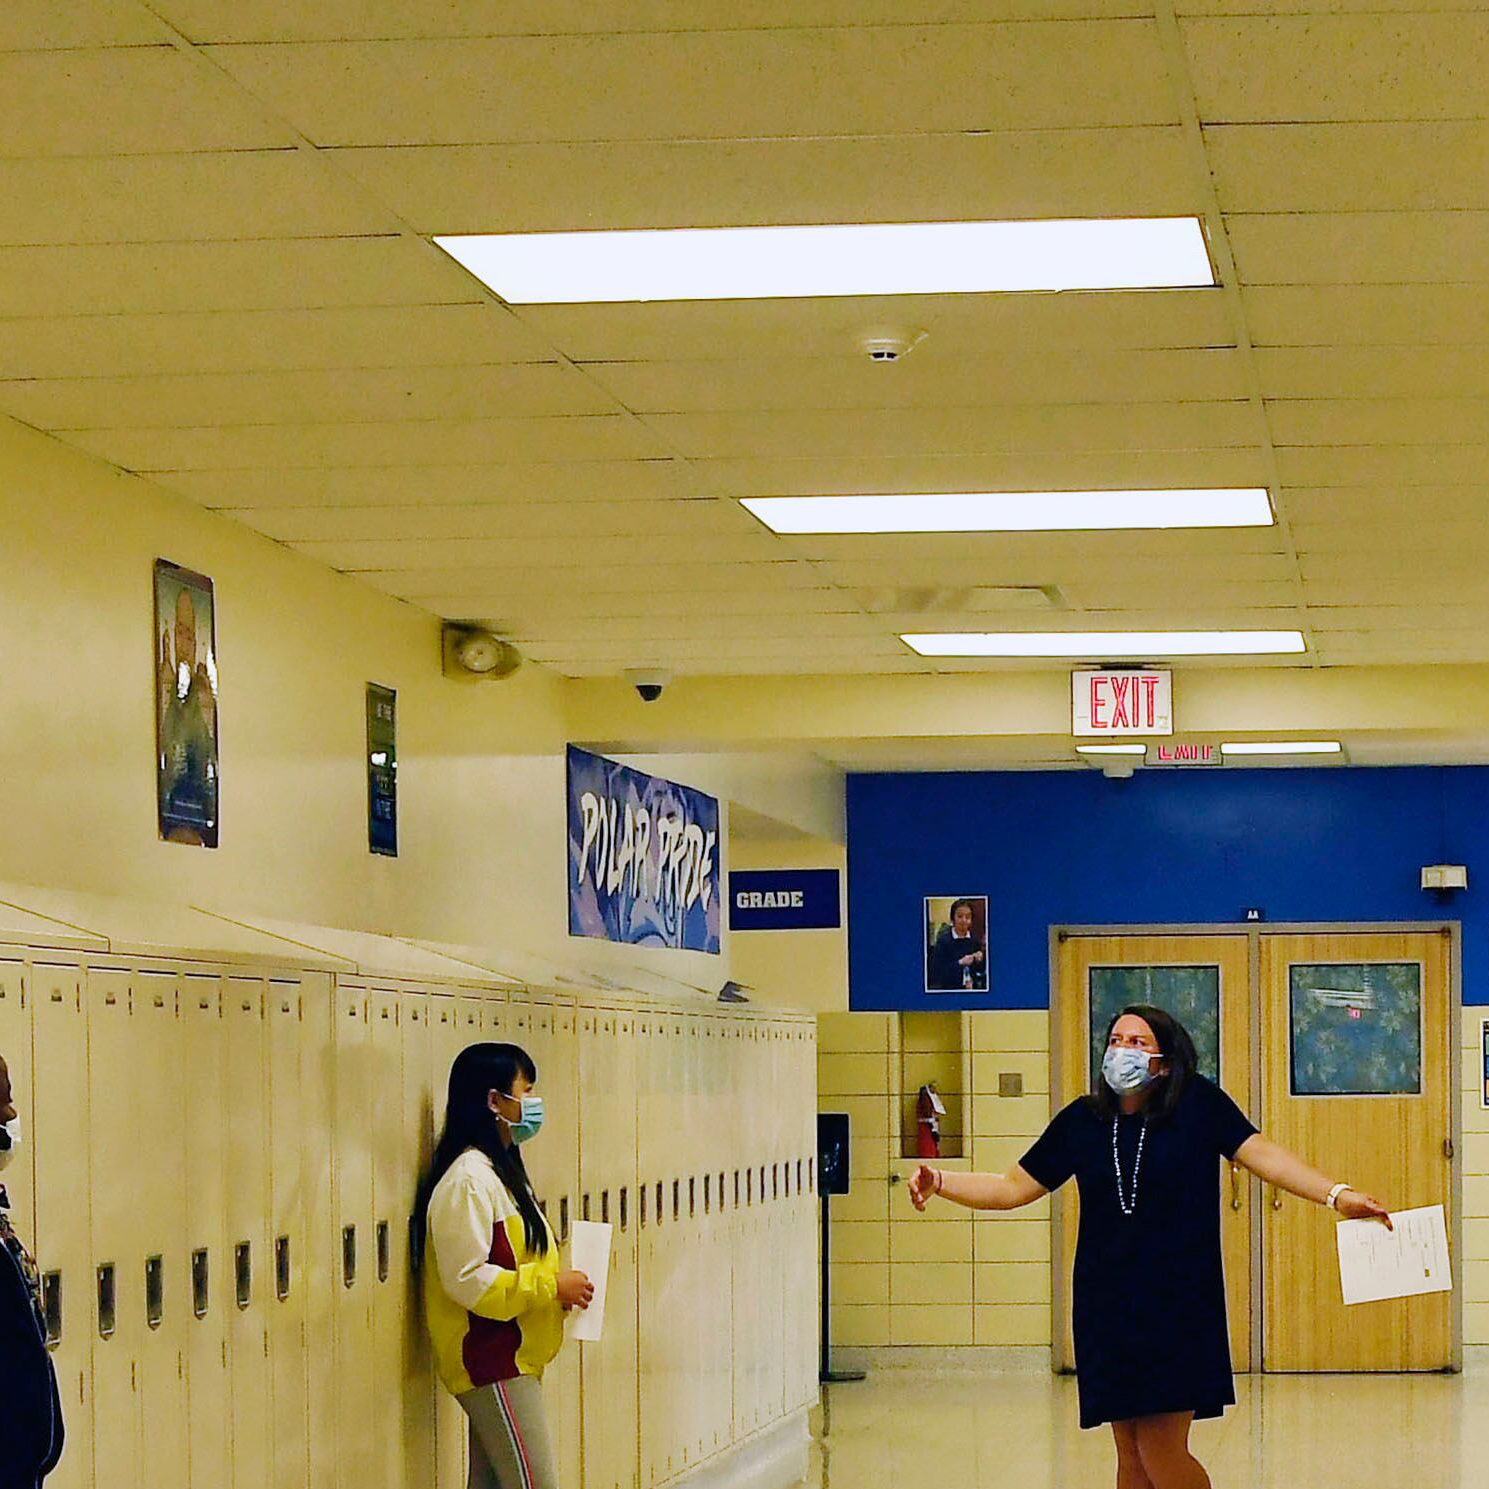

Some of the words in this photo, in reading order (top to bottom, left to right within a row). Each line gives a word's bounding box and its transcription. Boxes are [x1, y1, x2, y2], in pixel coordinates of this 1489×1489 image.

[1090, 676, 1160, 729] EXIT
[577, 791, 651, 900] POLAR
[655, 816, 716, 913] PRIDE
[736, 891, 804, 909] GRADE
